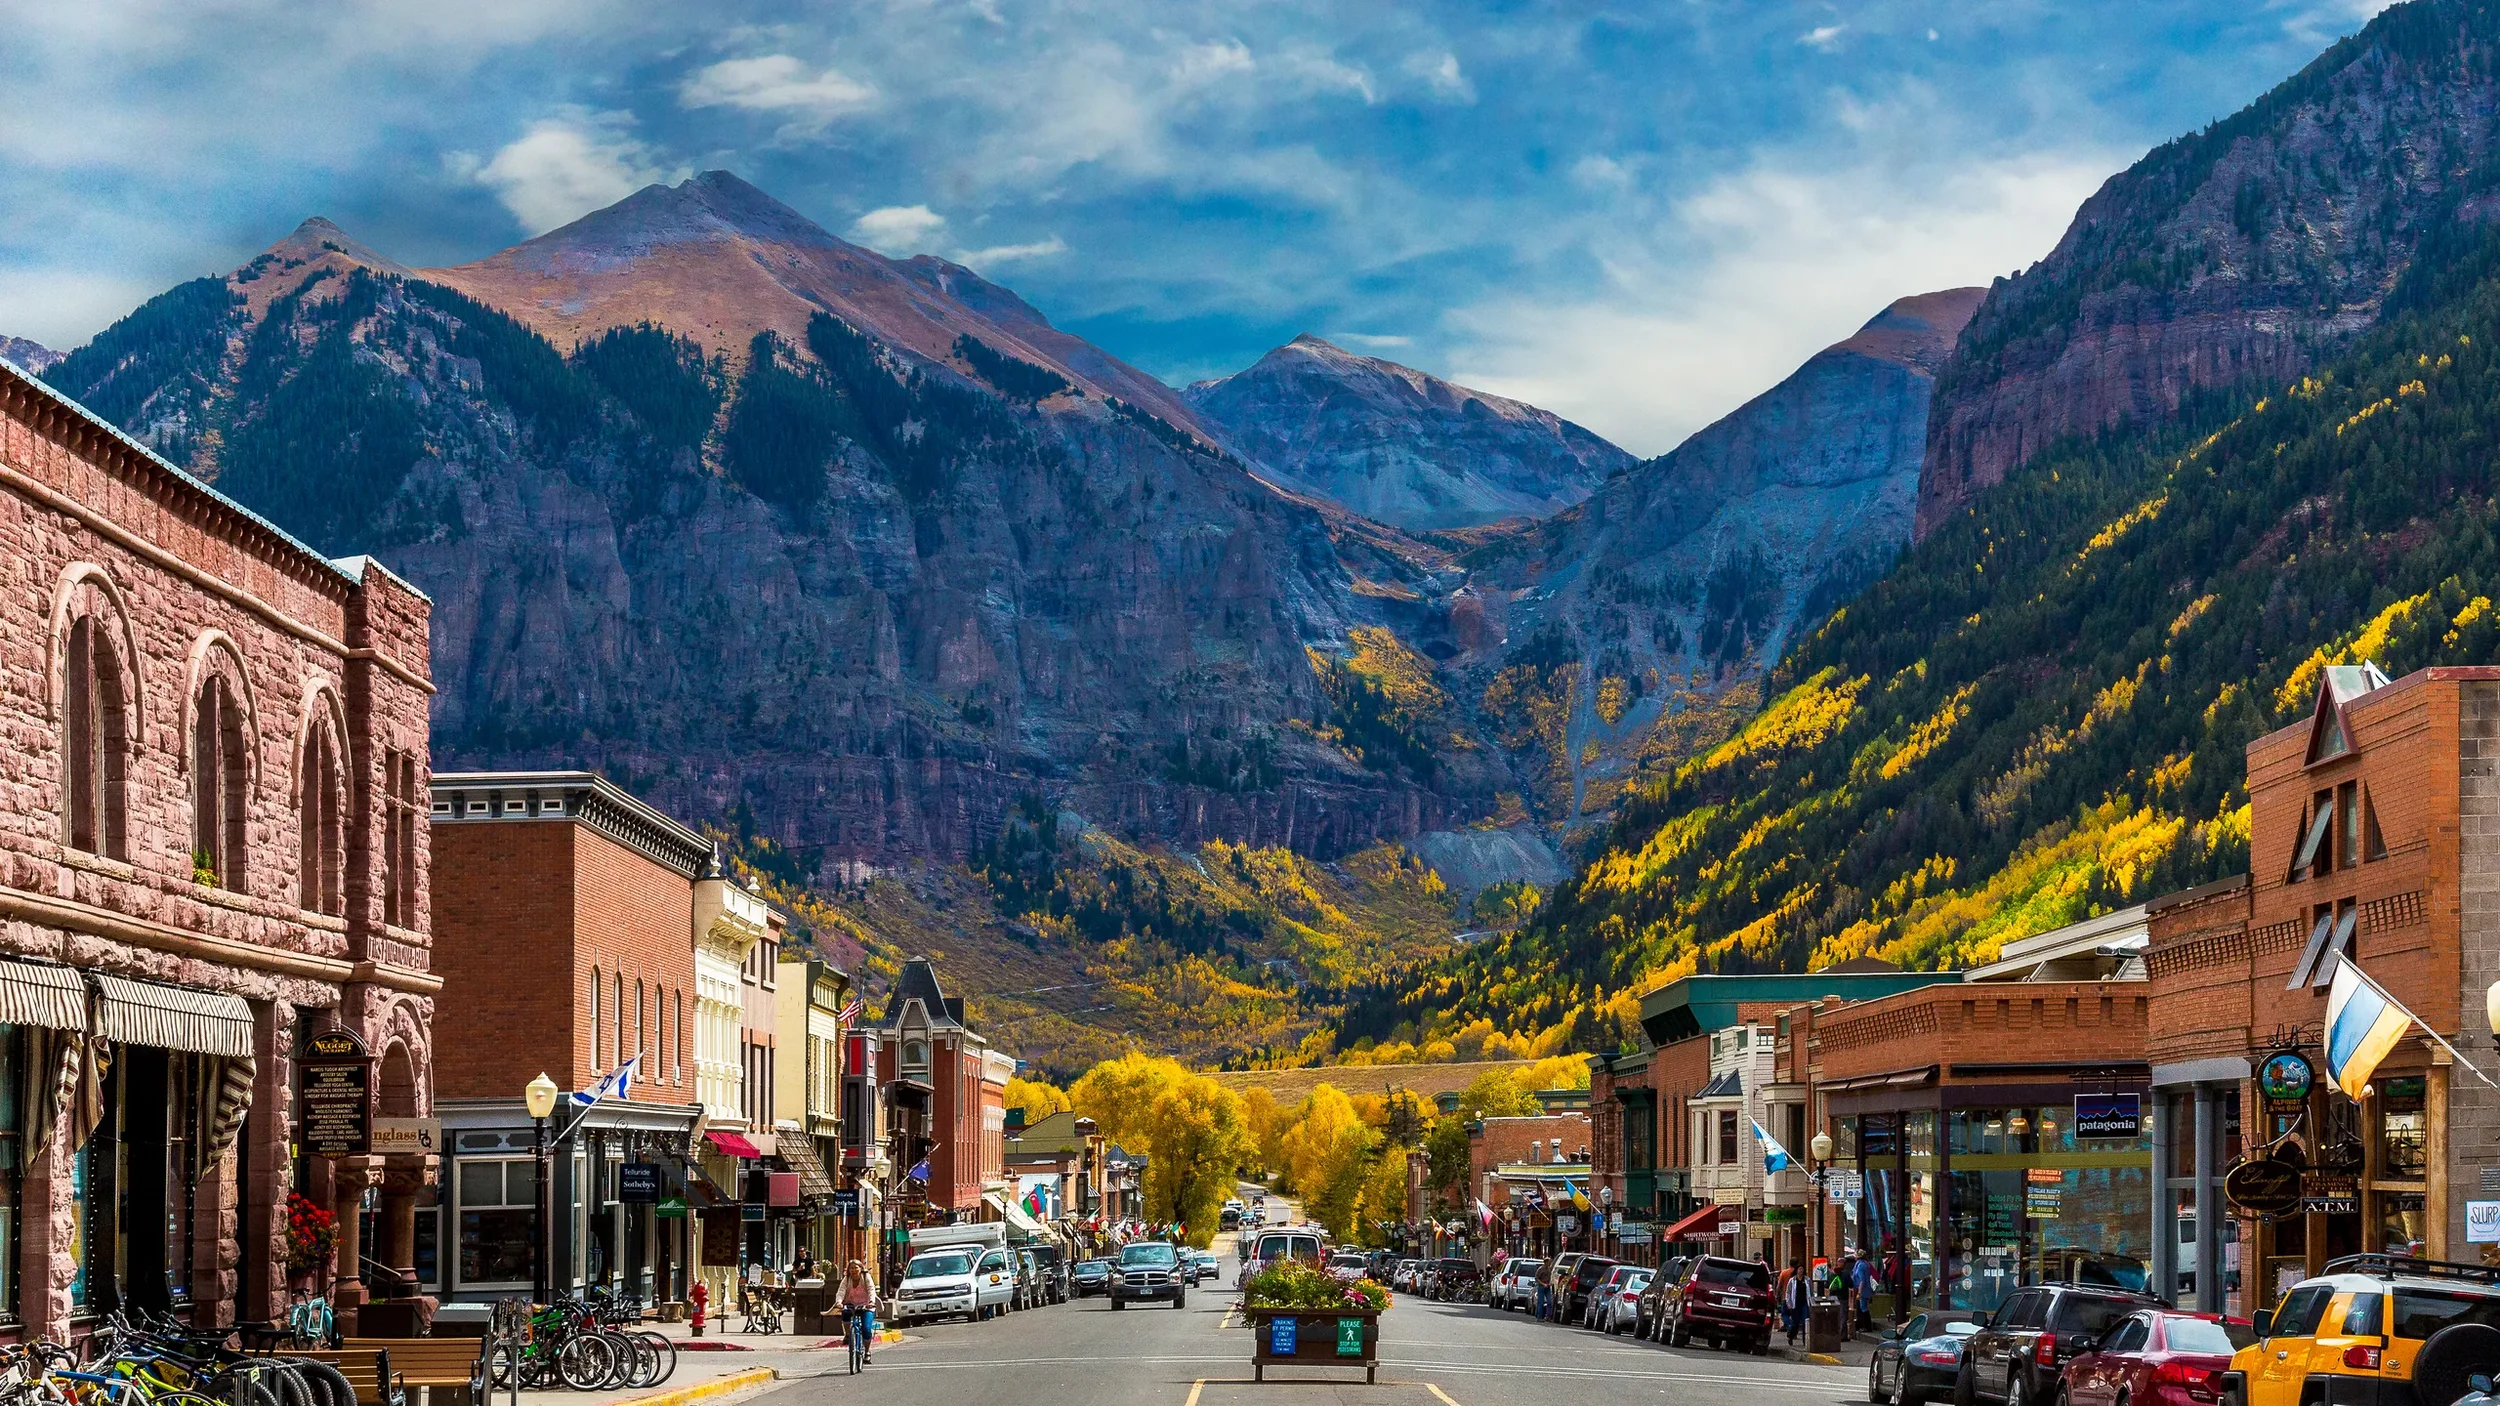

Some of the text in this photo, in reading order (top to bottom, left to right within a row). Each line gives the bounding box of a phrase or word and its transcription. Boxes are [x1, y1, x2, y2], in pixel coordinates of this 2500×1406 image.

[315, 1041, 353, 1055] NUGGET
[2079, 1120, 2135, 1131] patagonia
[374, 1128, 417, 1144] nglass
[623, 1180, 656, 1189] Sotheby's
[2305, 1202, 2354, 1212] A.T.M.
[2470, 1206, 2499, 1224] SLURP
